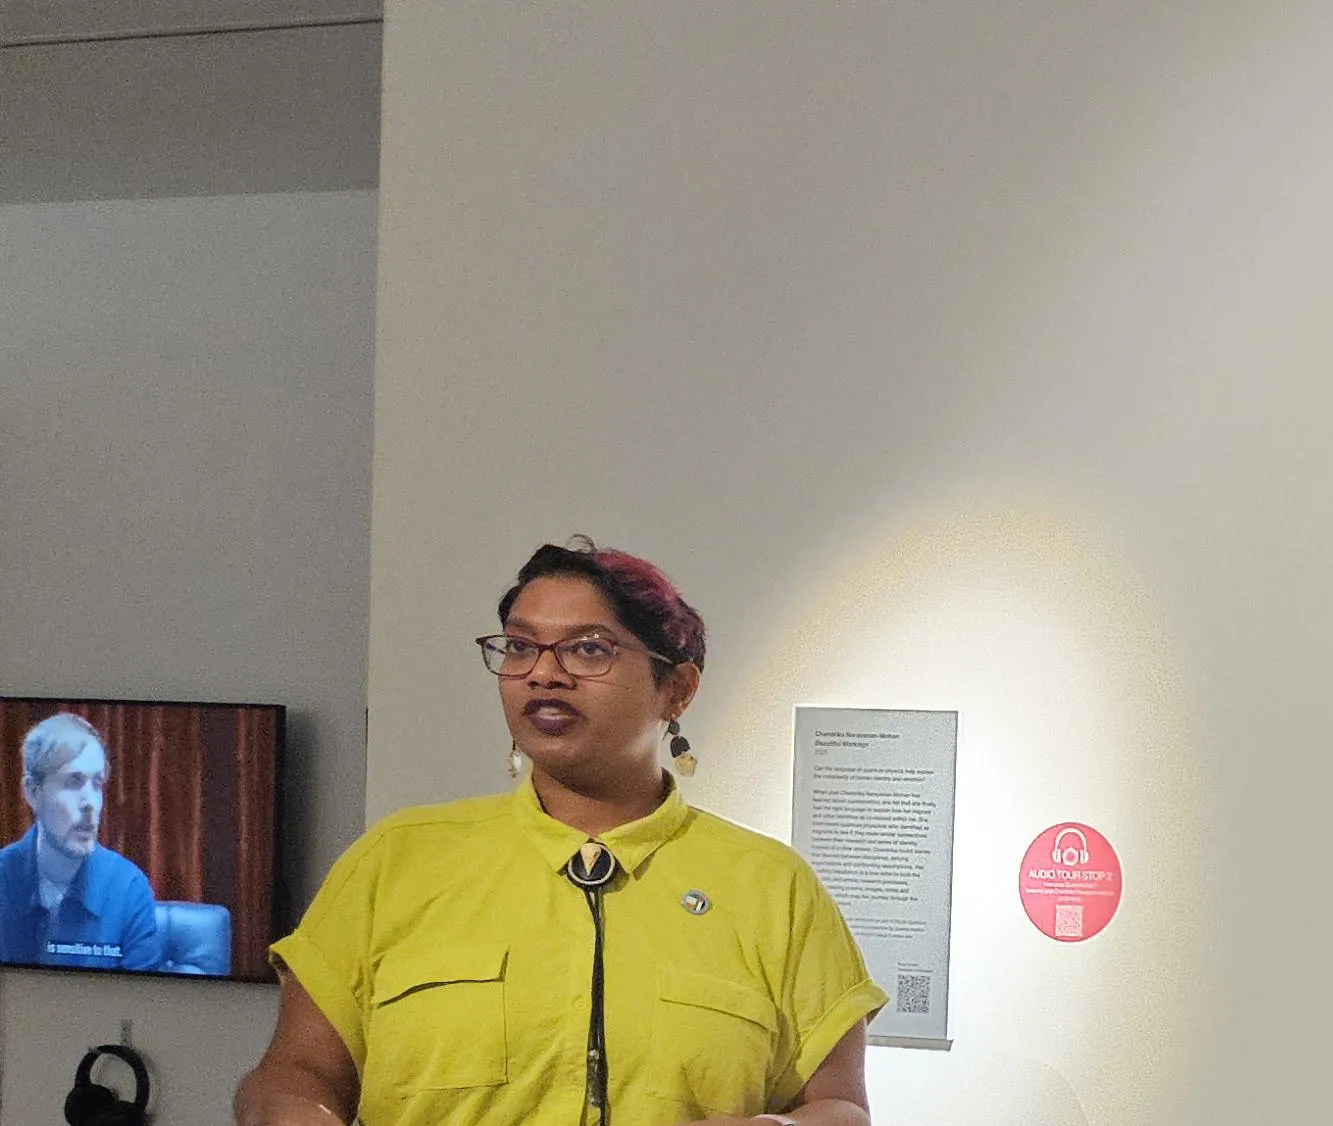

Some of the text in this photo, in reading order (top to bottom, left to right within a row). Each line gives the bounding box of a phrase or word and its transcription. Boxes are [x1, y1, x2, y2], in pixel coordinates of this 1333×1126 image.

[1028, 869, 1056, 879] AUDIO
[1057, 869, 1081, 880] TOUR
[1082, 870, 1106, 880] STOP
